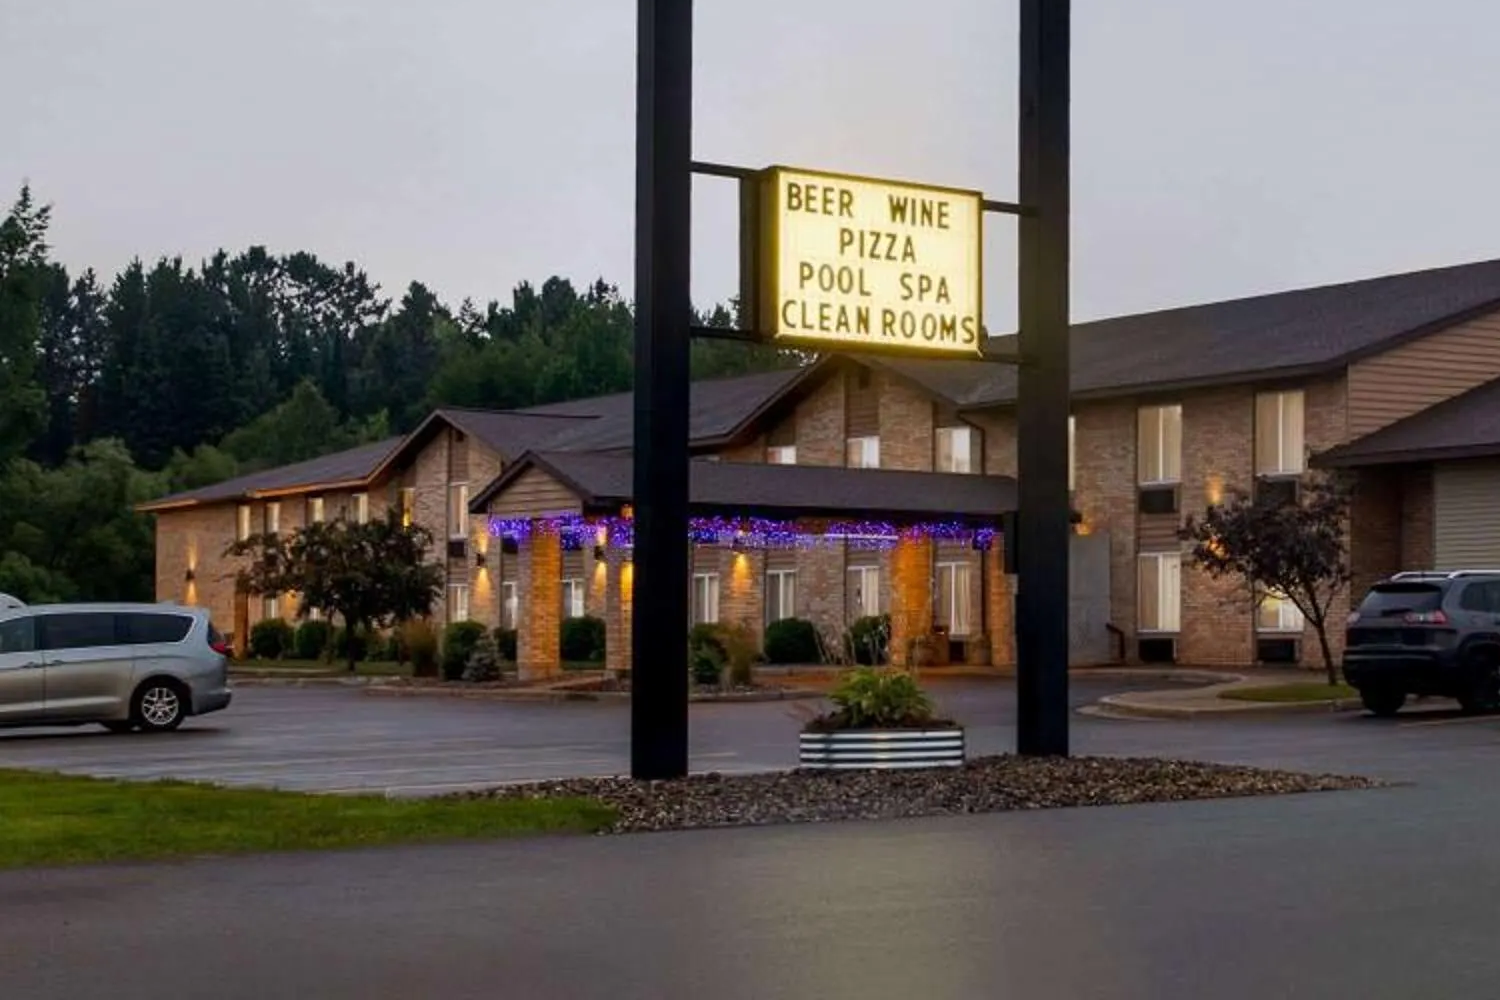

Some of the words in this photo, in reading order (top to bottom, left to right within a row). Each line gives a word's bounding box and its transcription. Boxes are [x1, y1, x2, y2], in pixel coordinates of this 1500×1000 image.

[787, 182, 854, 218] BEER
[888, 194, 950, 229] WINE
[839, 228, 916, 263] PIZZA
[799, 261, 872, 296] POOL
[900, 272, 951, 304] SPA
[781, 300, 870, 335] CLEAN
[881, 309, 975, 344] ROOMS
